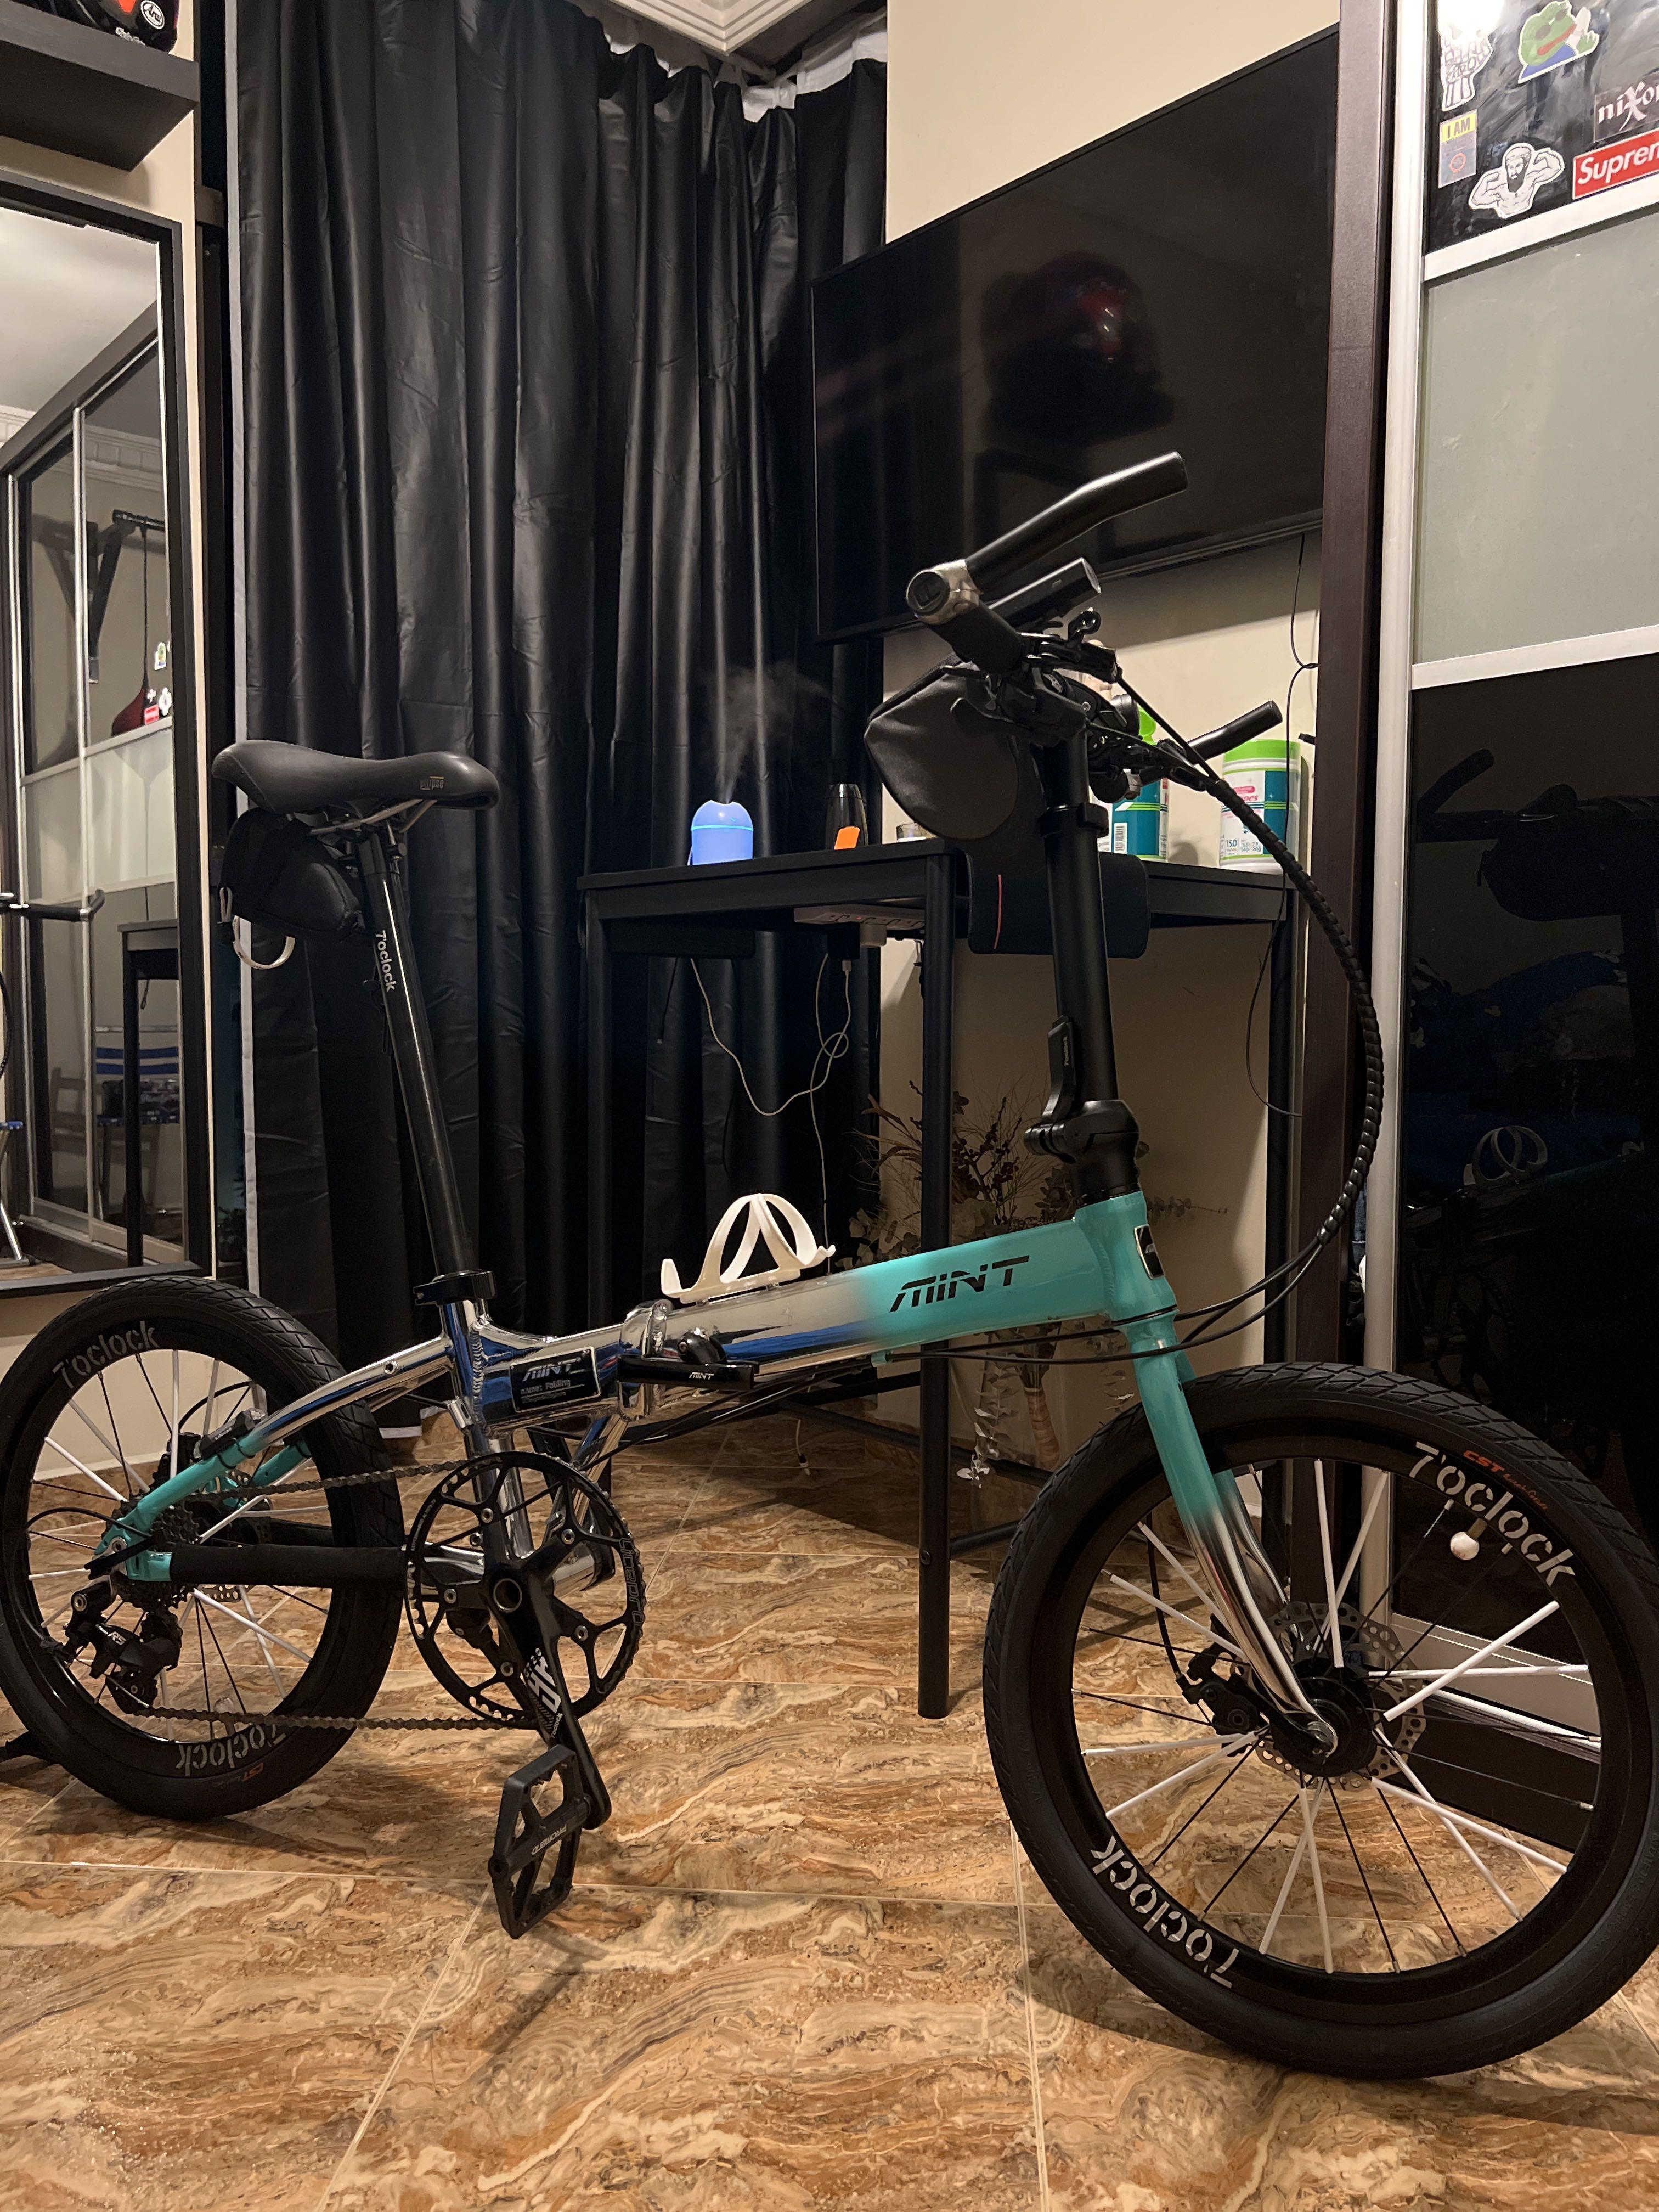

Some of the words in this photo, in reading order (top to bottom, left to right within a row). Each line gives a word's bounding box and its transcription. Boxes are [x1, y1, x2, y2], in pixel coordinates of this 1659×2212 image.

[1447, 124, 1451, 138] I
[1453, 117, 1471, 136] AM
[1226, 839, 1237, 848] 150
[889, 1254, 1030, 1313] MINT
[522, 1358, 578, 1382] MINT
[689, 1371, 715, 1380] MINT
[1463, 1449, 1505, 1473] CST
